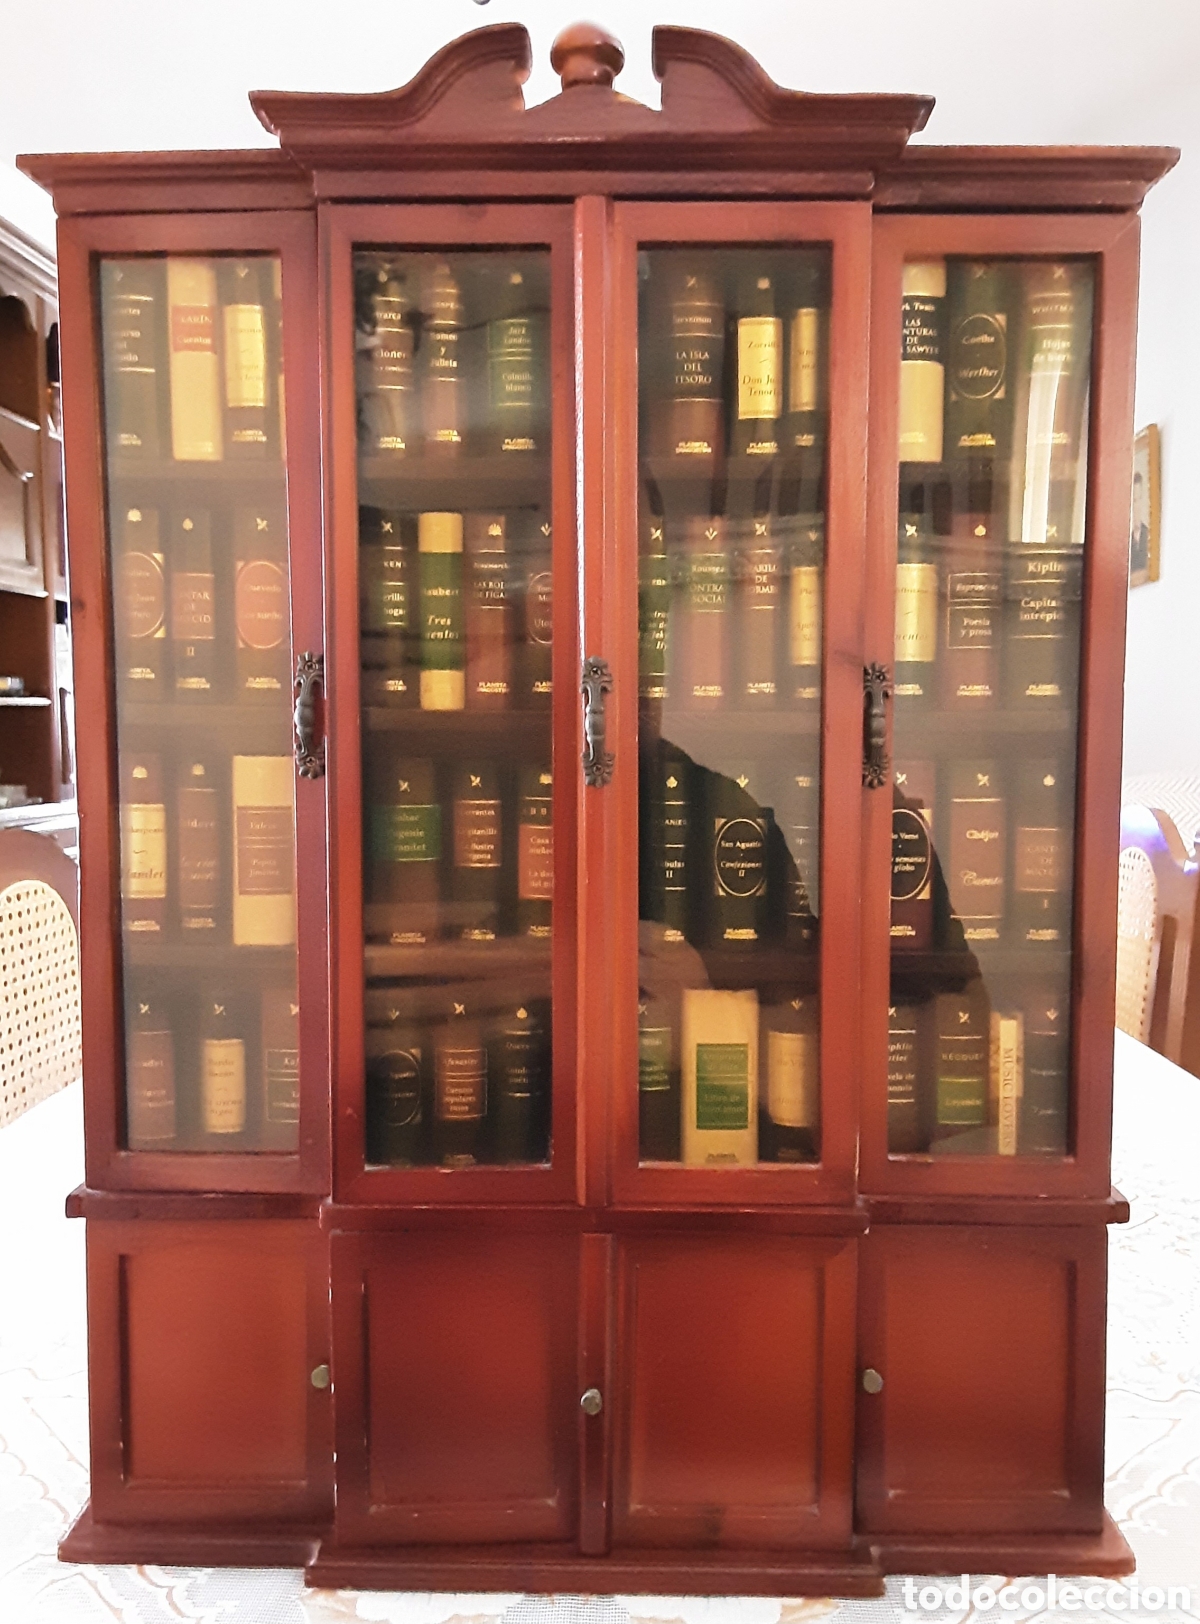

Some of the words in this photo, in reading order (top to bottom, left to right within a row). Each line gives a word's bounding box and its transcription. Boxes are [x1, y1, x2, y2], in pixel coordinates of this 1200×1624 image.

[905, 319, 921, 327] LAS
[690, 351, 709, 360] ISLA
[684, 363, 703, 371] DEL
[675, 375, 712, 384] TESORO
[1027, 562, 1066, 574] Kiplin
[755, 575, 768, 583] DE
[1002, 1048, 1015, 1092] MUSIC
